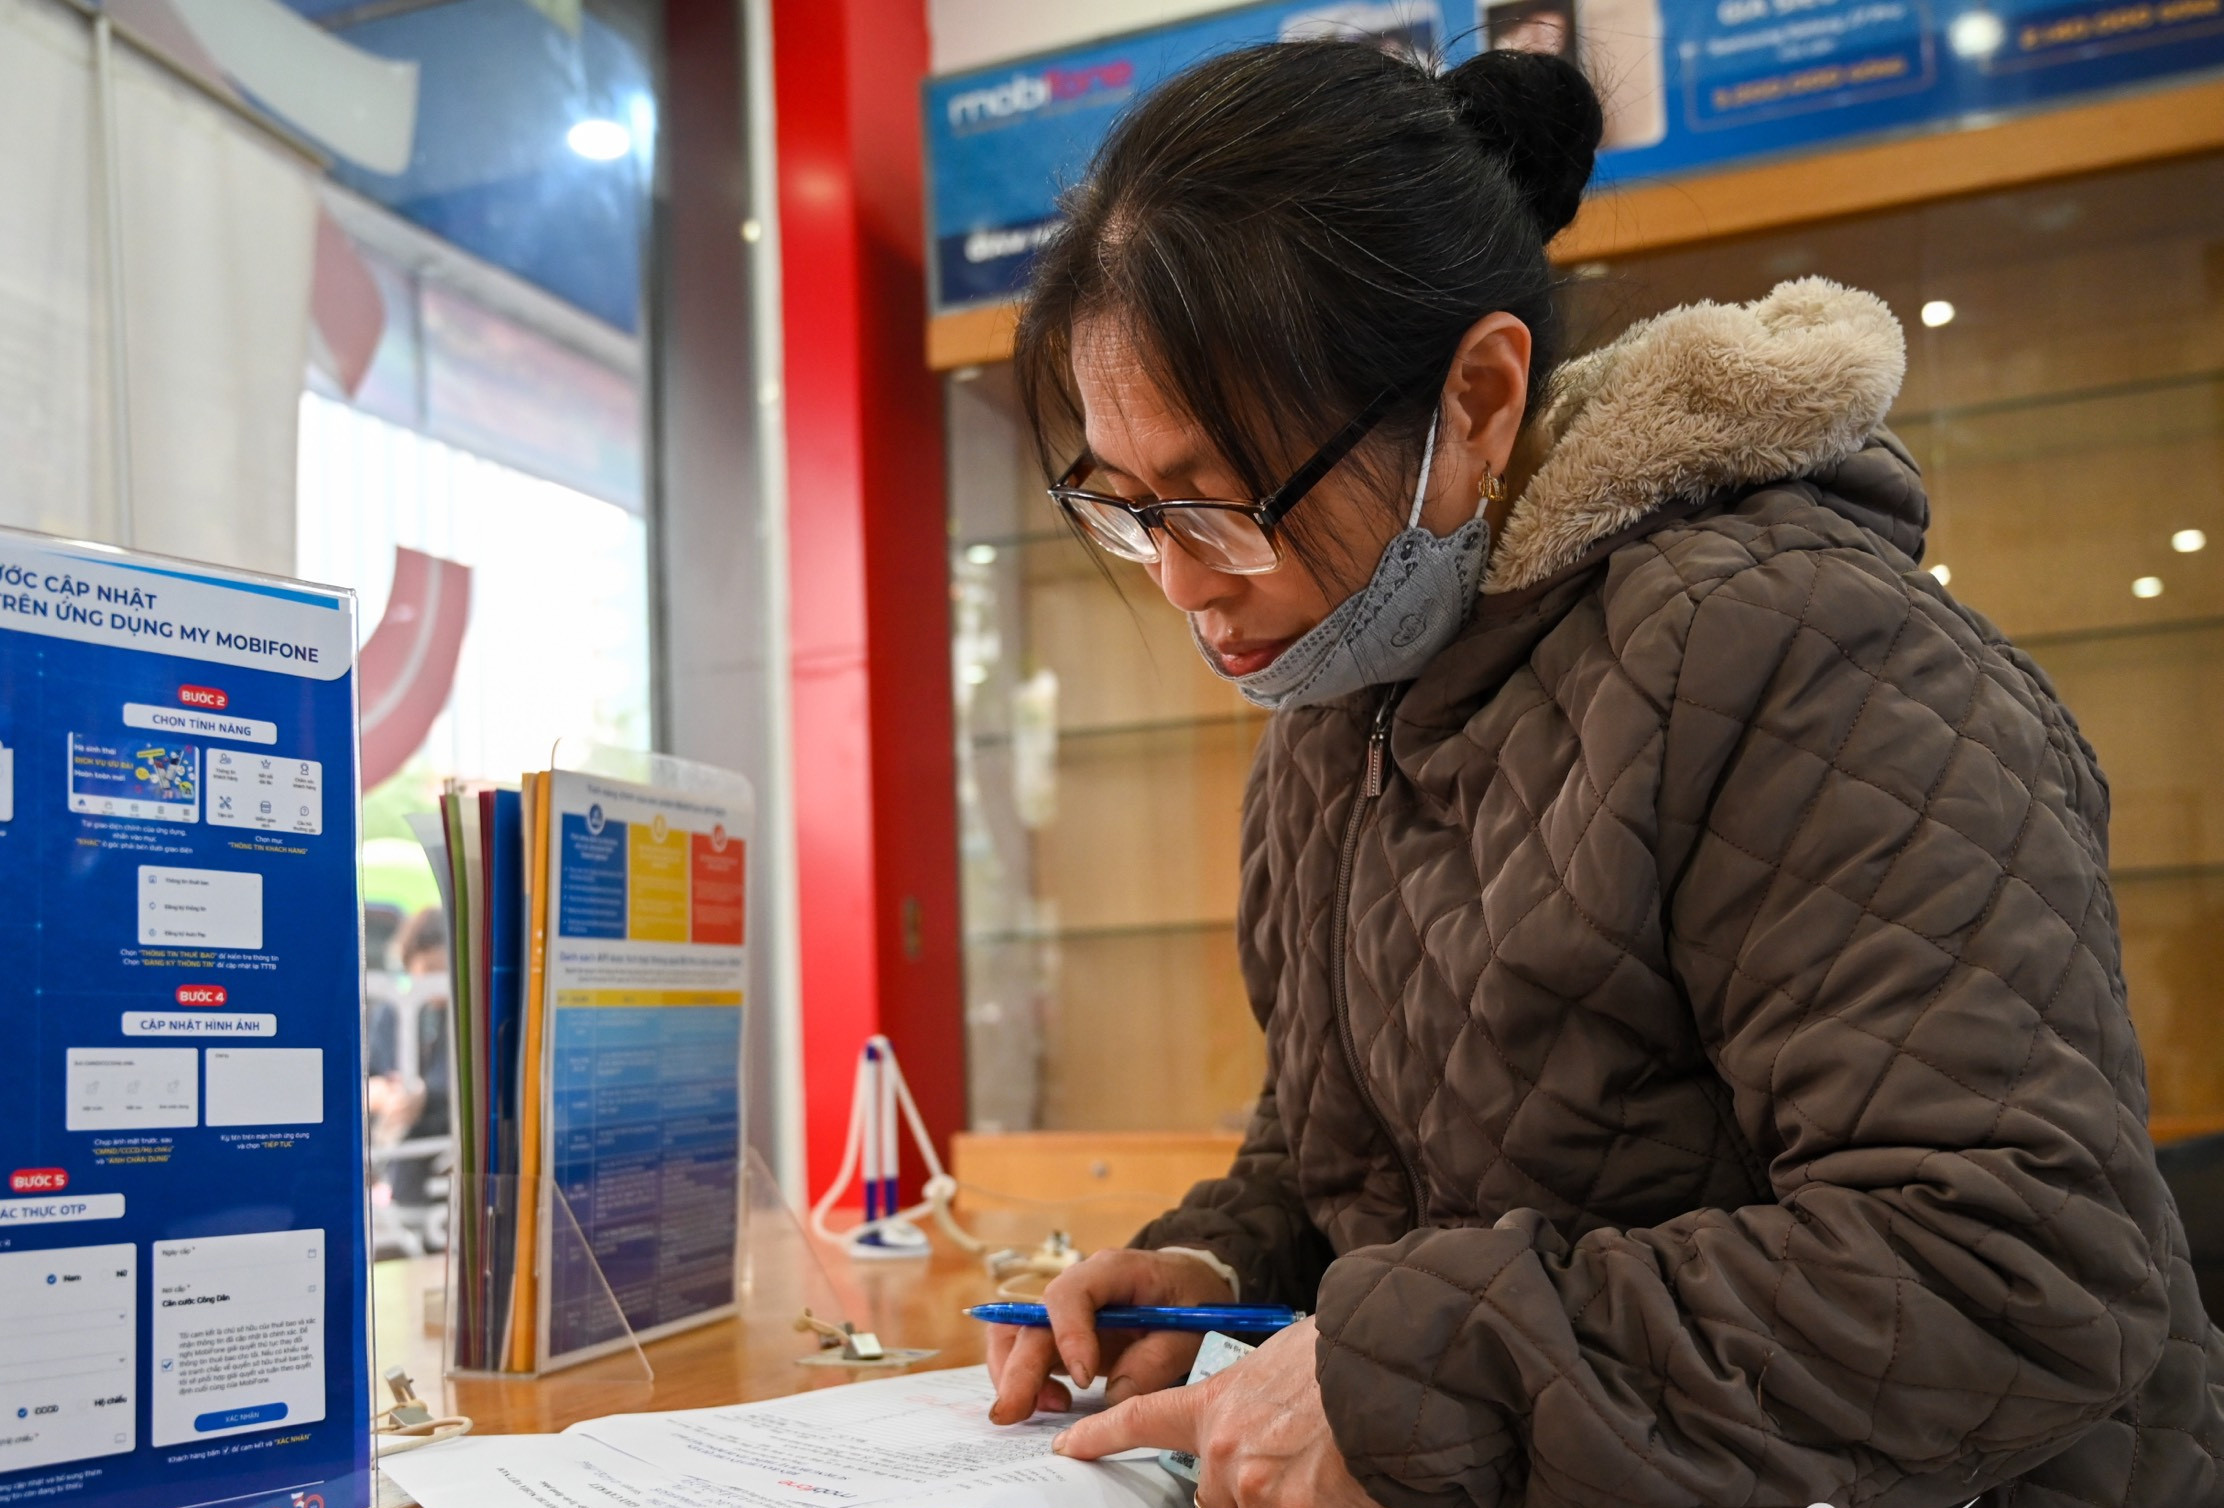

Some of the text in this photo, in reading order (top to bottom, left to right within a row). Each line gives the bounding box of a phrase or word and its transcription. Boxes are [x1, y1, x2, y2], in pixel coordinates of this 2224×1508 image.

[44, 575, 91, 600] CẬP
[97, 586, 157, 612] NHẬT
[0, 593, 319, 663] RÊN ỨNG DỤNG MY MOBIFONE
[181, 689, 226, 707] BƯỚC 2
[152, 714, 186, 727] CHỌN
[180, 990, 225, 1003] BƯỚC 4
[140, 1017, 260, 1033] CẬP NHẬT HÌNH ẢNH
[13, 1173, 66, 1189] BƯỚC 5
[60, 1203, 87, 1216] OTP
[63, 1273, 82, 1283] Nam
[162, 1299, 177, 1308] Căn
[197, 1295, 216, 1304] Công
[216, 1294, 231, 1302] Dân
